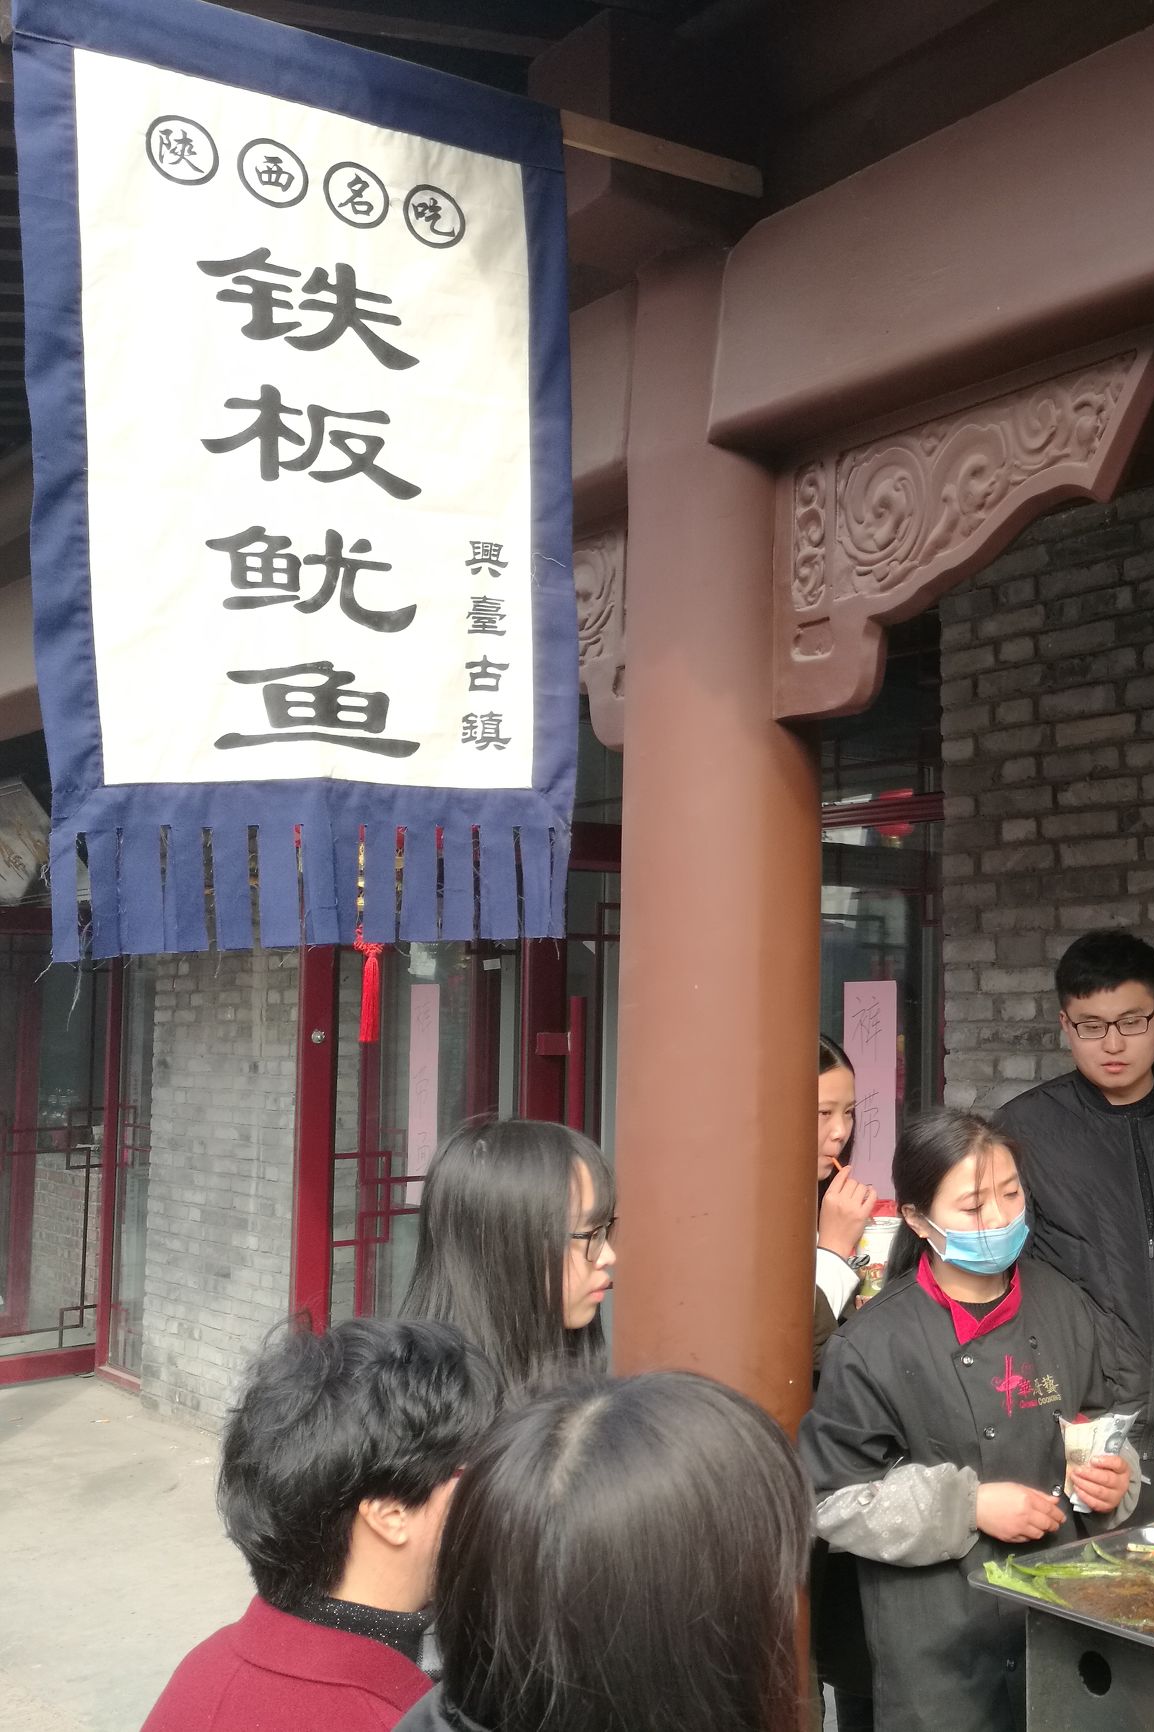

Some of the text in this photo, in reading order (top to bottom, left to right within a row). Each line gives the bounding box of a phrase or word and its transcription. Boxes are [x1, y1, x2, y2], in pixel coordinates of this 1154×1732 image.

[197, 247, 422, 758] 铁板鱿鱼
[461, 540, 512, 751] 興臺古鎮
[850, 994, 883, 1199] 裤带
